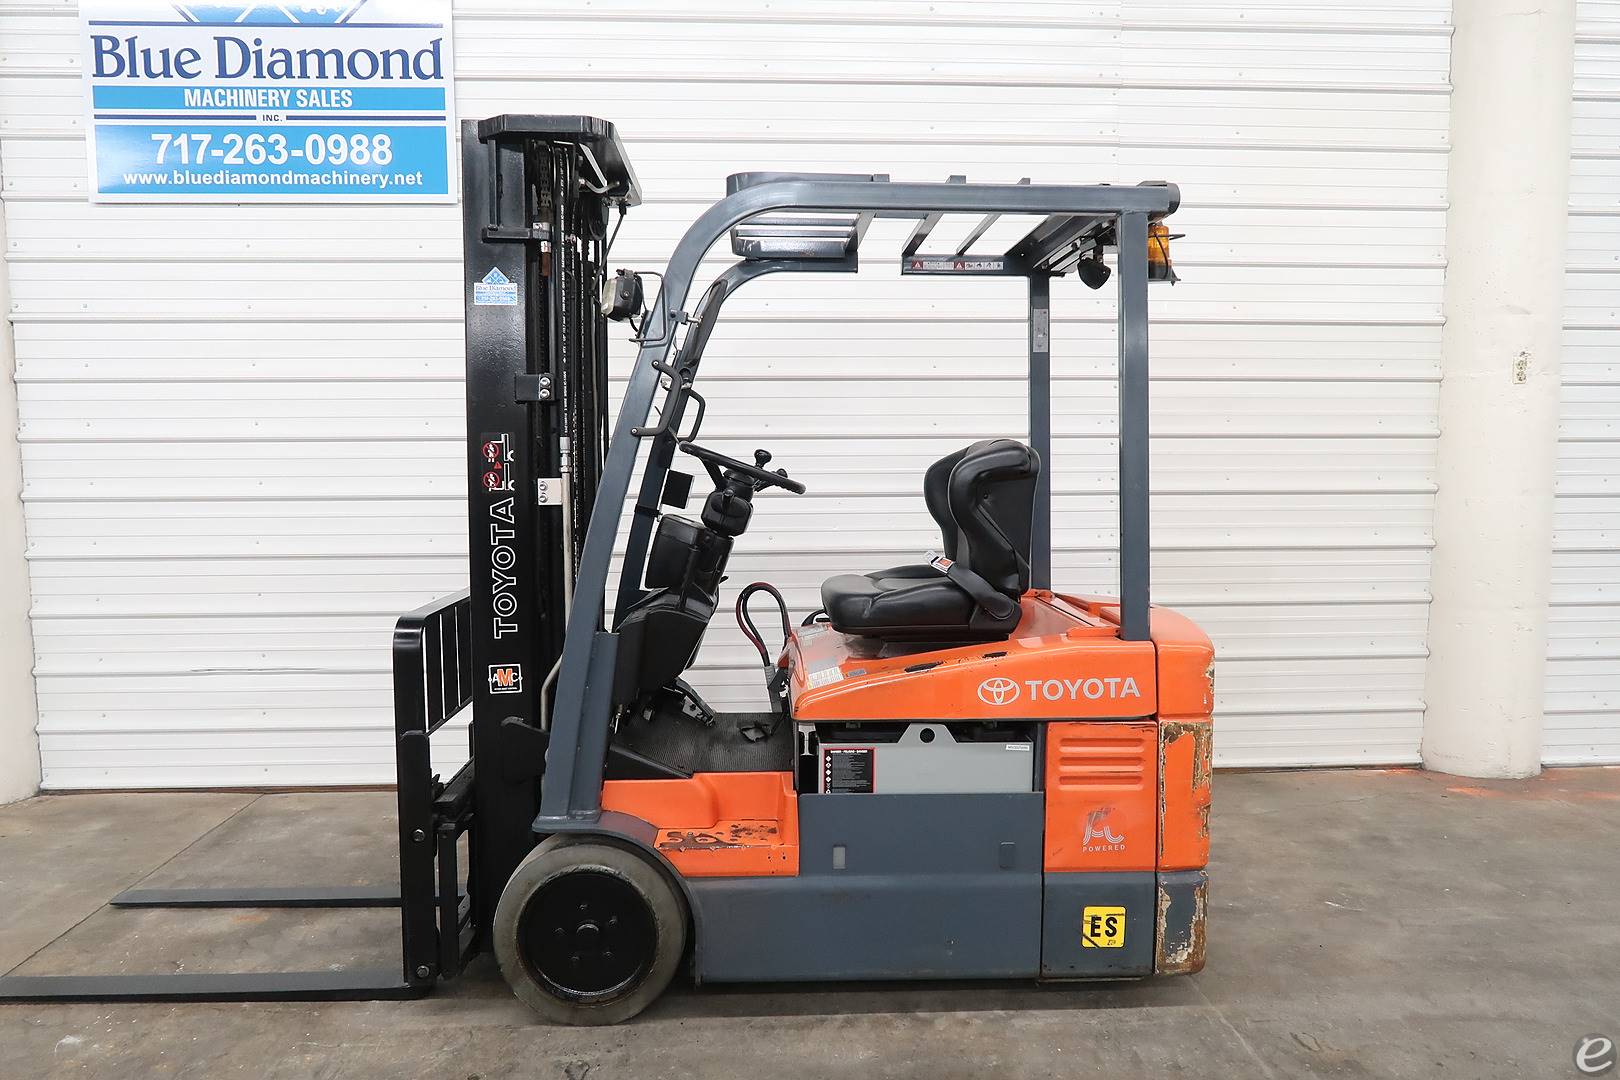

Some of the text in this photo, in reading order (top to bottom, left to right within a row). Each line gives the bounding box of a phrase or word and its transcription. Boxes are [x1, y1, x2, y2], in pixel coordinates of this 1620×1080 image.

[90, 34, 444, 80] Blue Diamond
[184, 88, 353, 109] MACHINERY SALES
[262, 114, 283, 122] INC.
[151, 133, 394, 166] 717-263-0988
[123, 169, 424, 188] www.bluediamondmachinery.net
[489, 497, 518, 640] TOYOTA
[492, 668, 519, 687] AMC
[1025, 677, 1141, 701] TOYOTA
[1082, 844, 1126, 853] POWERED
[1090, 916, 1118, 938] ES
